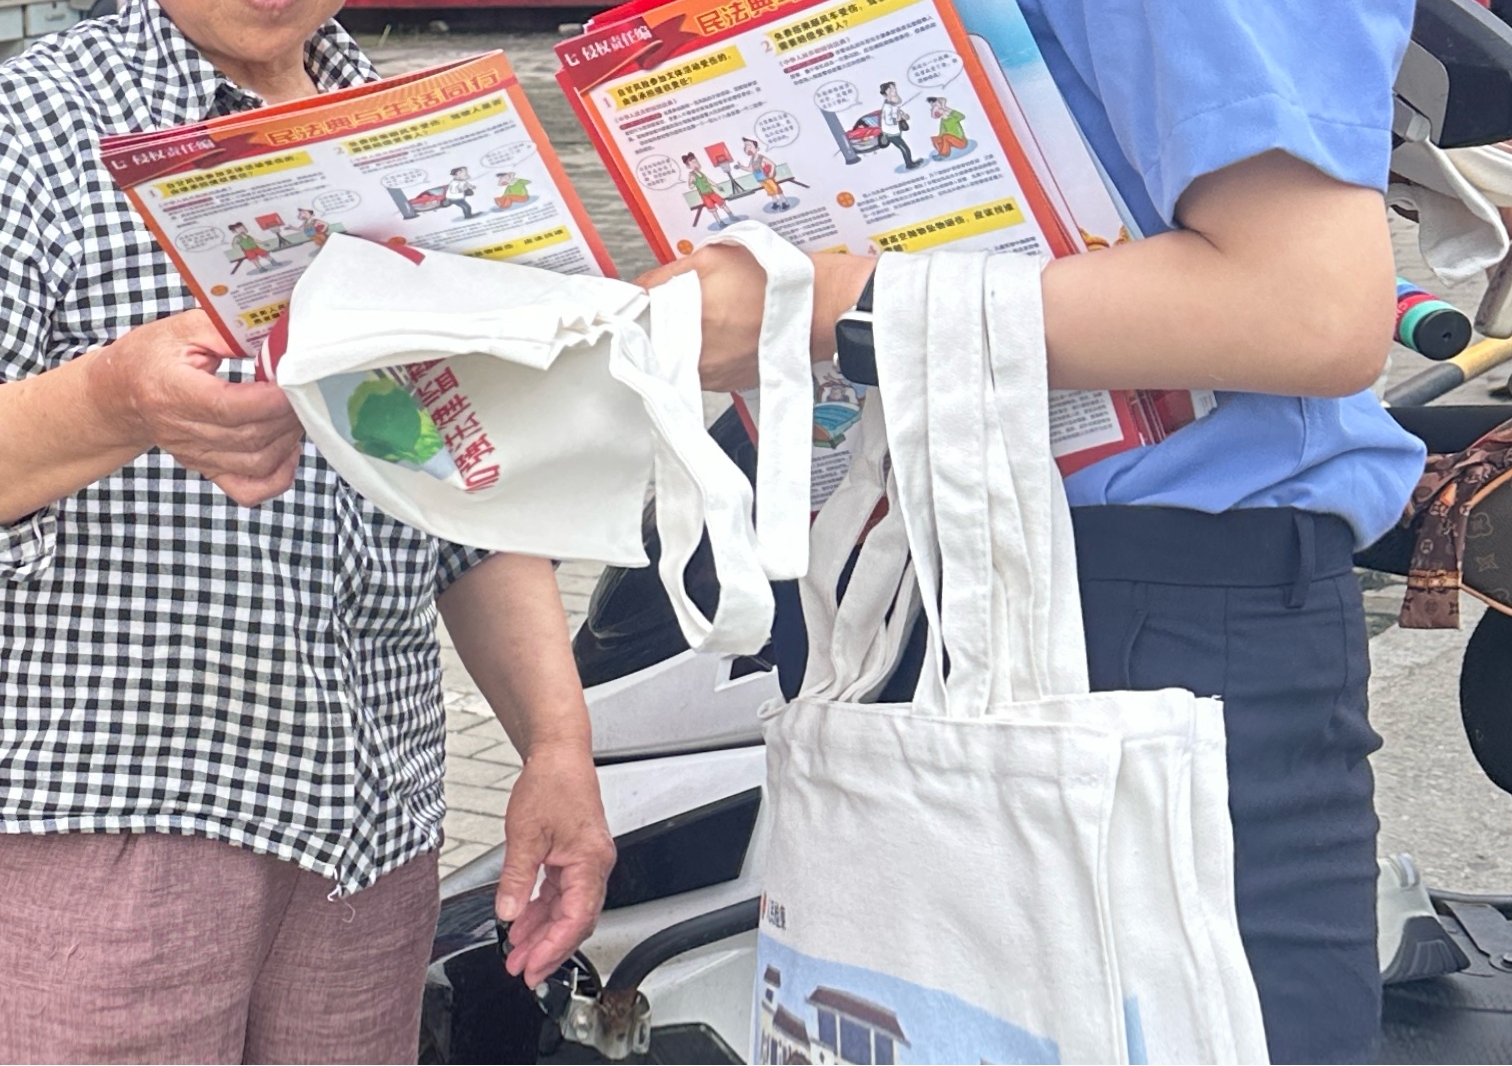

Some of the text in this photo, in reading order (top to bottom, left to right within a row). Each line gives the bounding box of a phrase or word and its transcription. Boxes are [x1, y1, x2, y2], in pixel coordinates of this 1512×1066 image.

[266, 69, 500, 147] 民法典与生活同行
